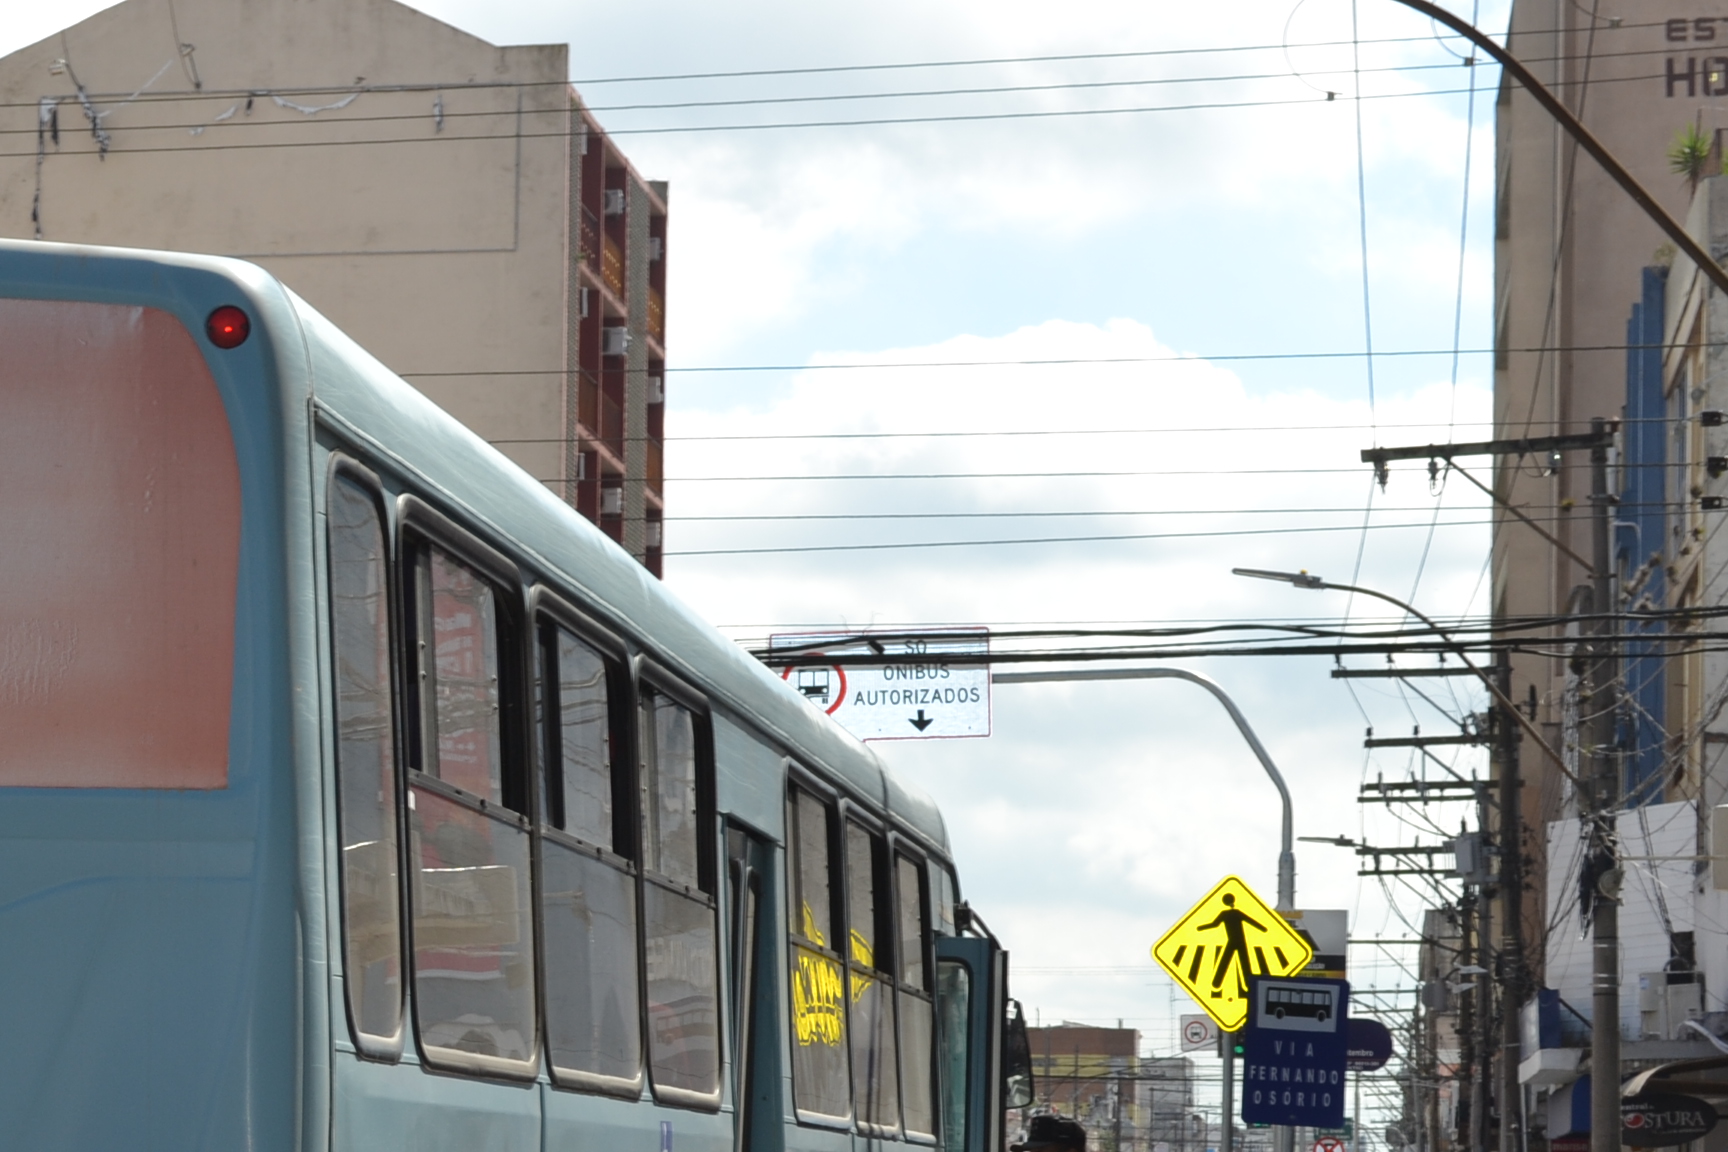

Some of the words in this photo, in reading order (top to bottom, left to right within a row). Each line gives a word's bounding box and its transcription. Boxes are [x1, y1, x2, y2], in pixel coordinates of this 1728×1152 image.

[853, 687, 981, 706] AUTORIZADOS
[1274, 1040, 1315, 1058] VIA
[1248, 1064, 1340, 1085] FERNANDO
[1252, 1087, 1332, 1107] OSÓRIO
[1620, 1102, 1648, 1111] entral
